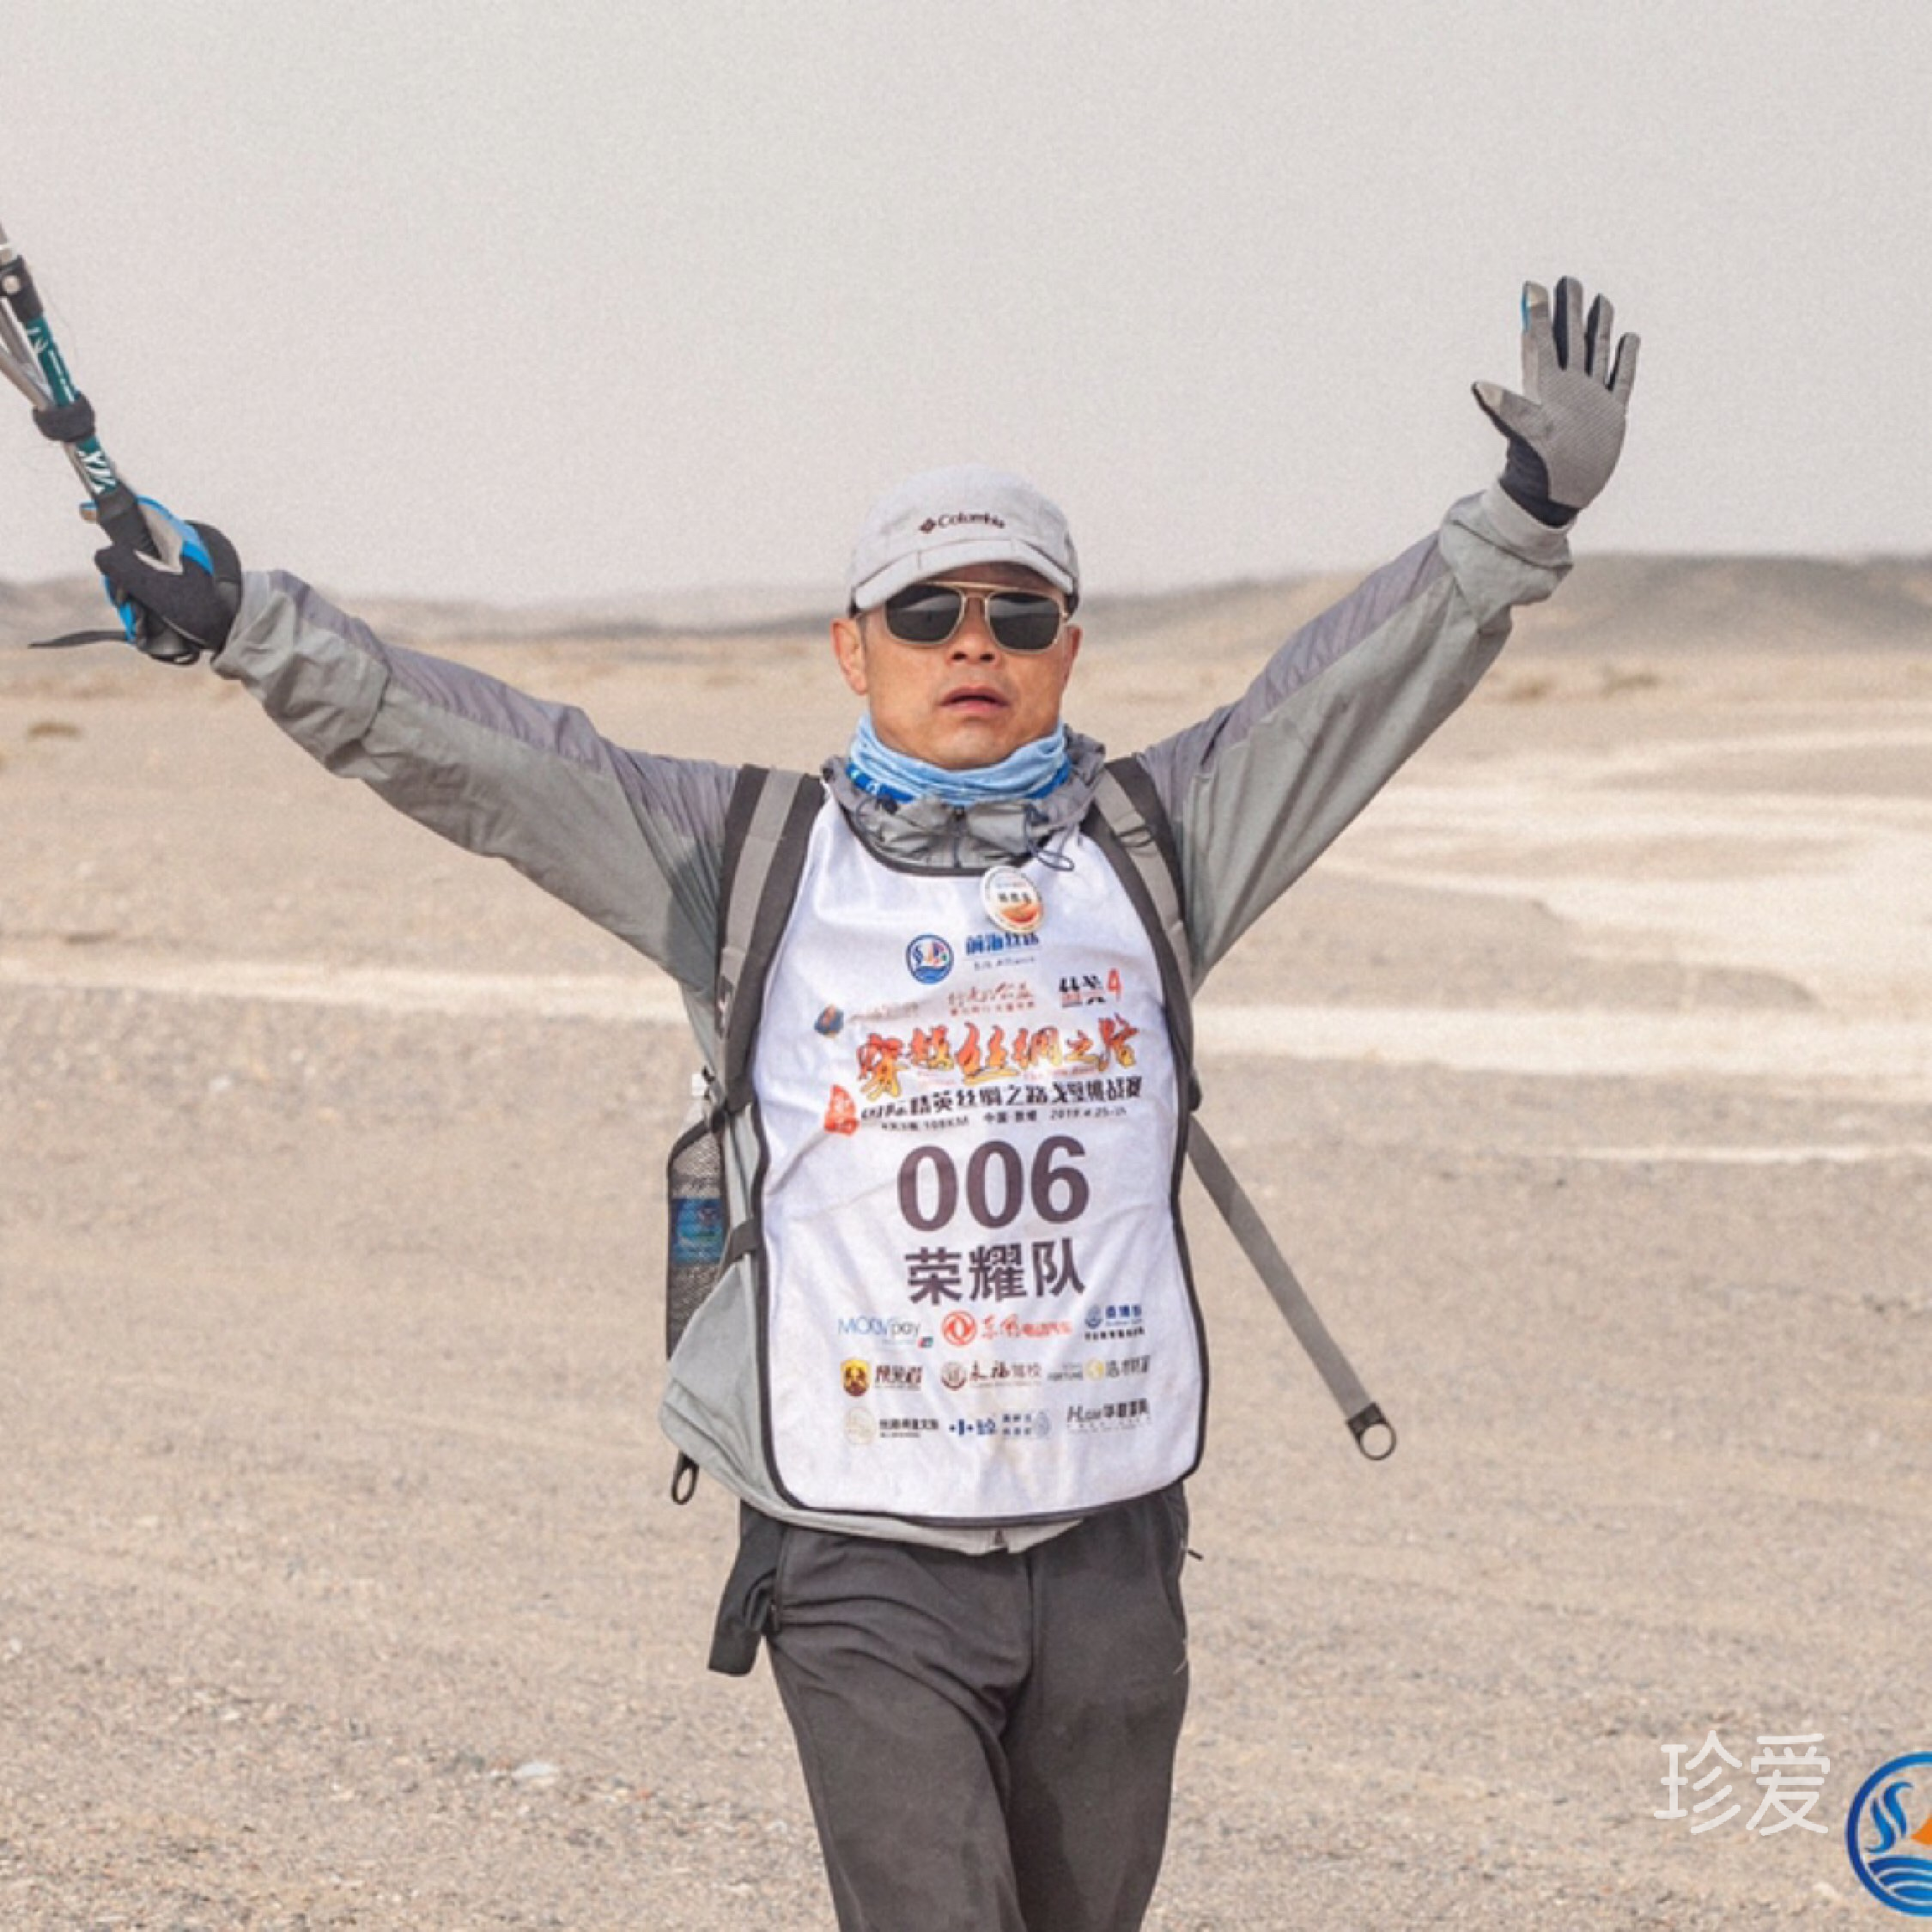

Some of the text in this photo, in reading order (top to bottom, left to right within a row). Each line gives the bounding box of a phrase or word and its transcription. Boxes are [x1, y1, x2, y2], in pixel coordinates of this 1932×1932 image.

[939, 511, 1005, 529] Columbia
[896, 1135, 1091, 1232] 006
[904, 1236, 1086, 1305] 荣耀队
